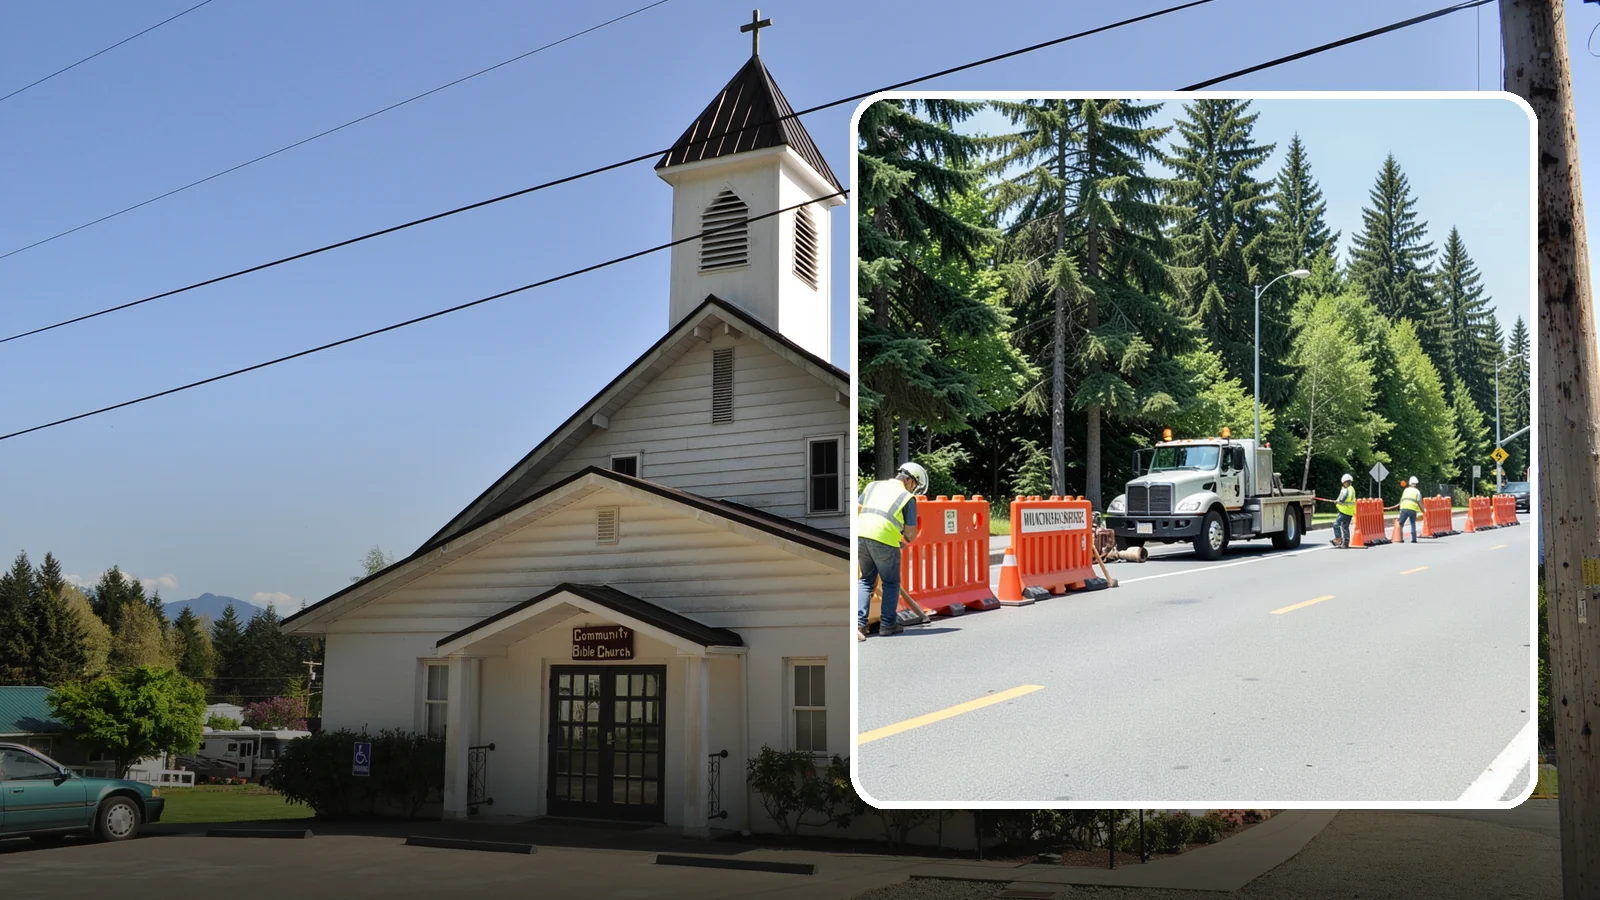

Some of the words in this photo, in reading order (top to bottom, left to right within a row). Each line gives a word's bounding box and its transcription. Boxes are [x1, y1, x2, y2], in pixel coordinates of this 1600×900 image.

[574, 627, 628, 641] Community
[573, 645, 595, 657] Bible
[597, 646, 631, 658] Church
